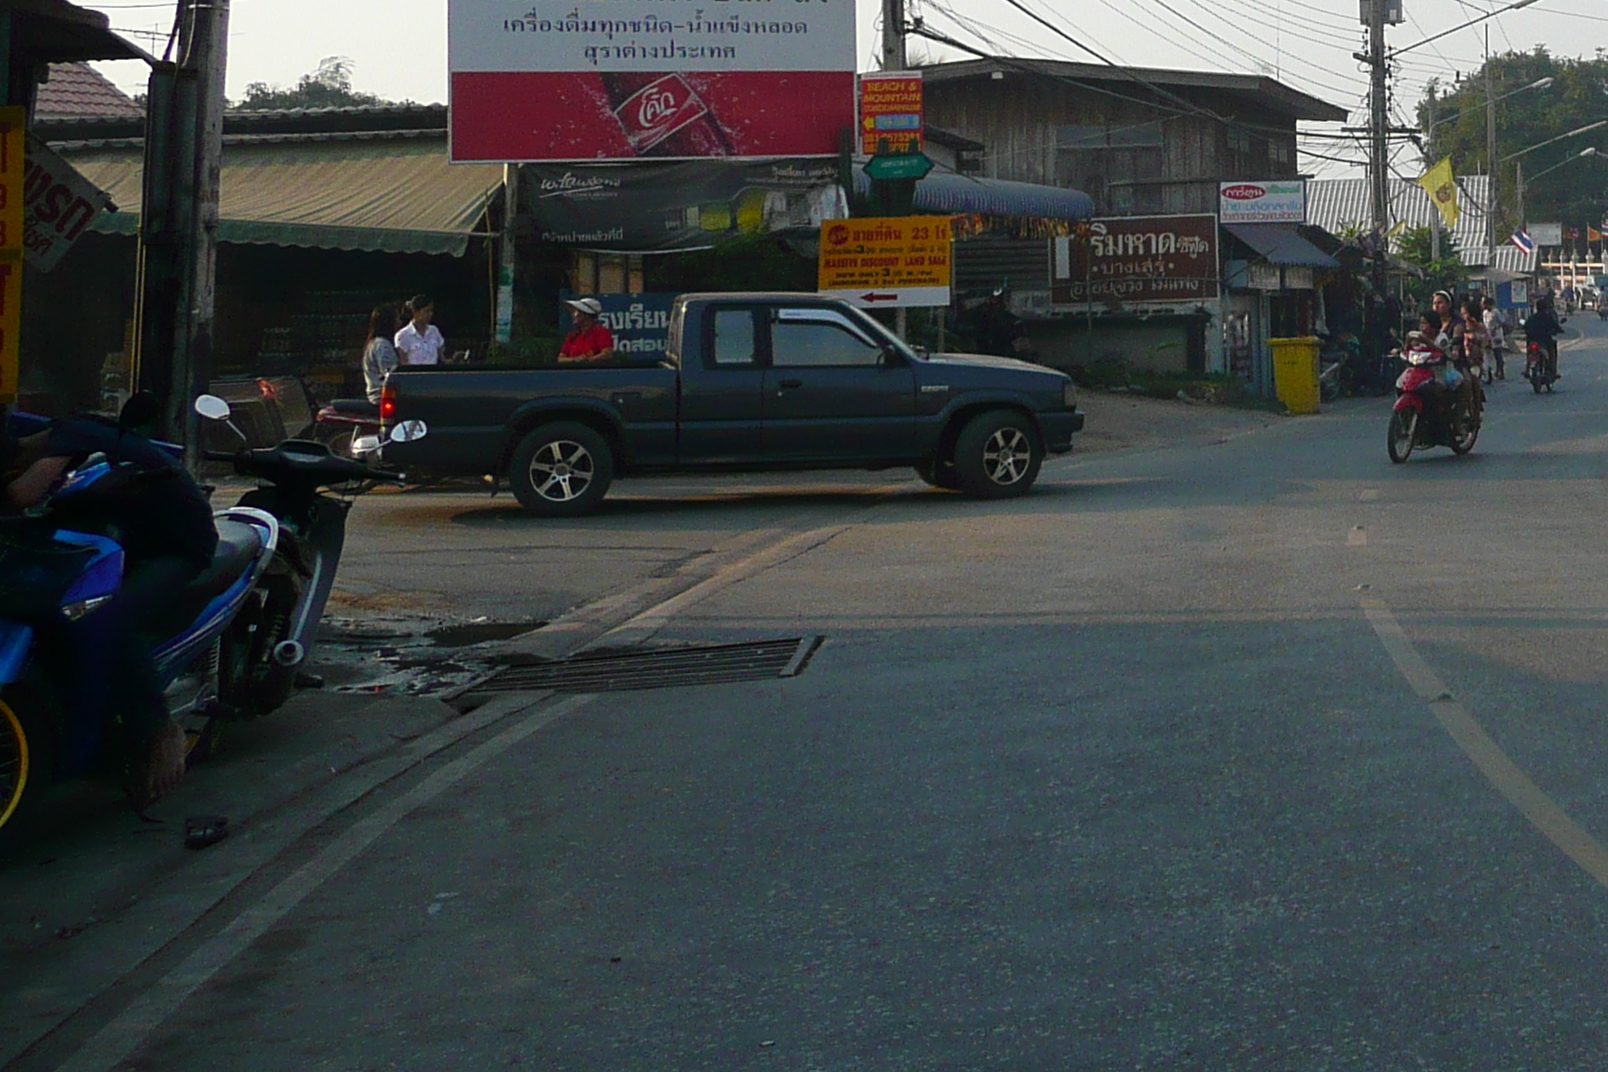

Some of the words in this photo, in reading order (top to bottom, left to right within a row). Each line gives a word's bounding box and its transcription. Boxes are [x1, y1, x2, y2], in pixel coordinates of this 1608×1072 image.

[503, 7, 808, 40] เครื่องดื่มทุกชนิด-น้ำแข็งหลอด
[583, 40, 737, 66] สุราต่างประเทศ
[867, 82, 905, 92] BEACH
[864, 94, 921, 103] MOUNTAIN
[912, 227, 929, 240] 23
[1090, 222, 1176, 258] ริมหาด
[860, 257, 899, 267] DISCOUNT
[904, 256, 925, 266] LAND
[928, 255, 947, 266] SALE
